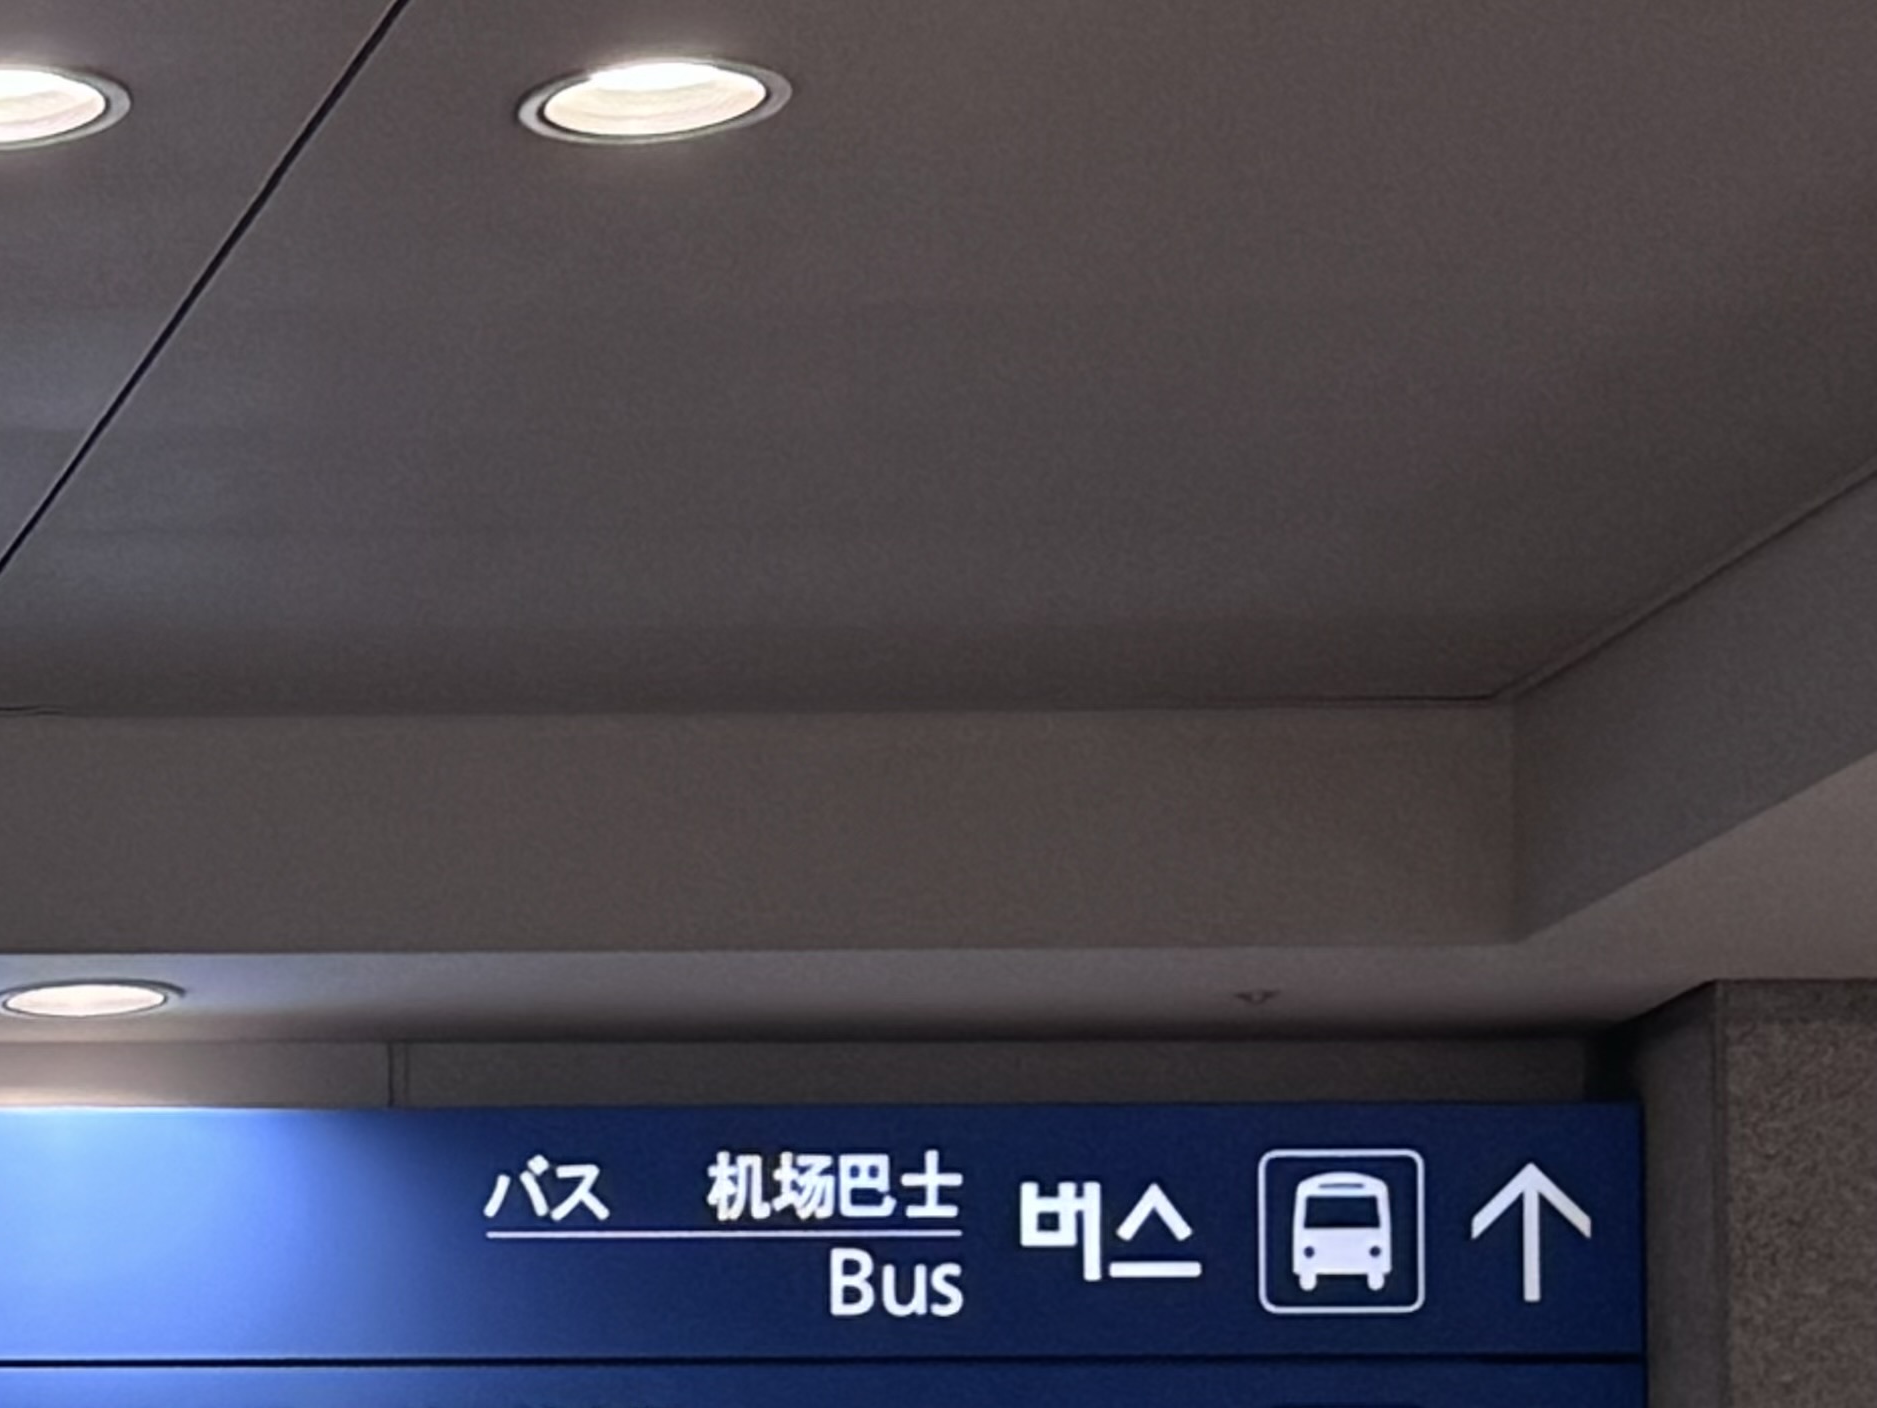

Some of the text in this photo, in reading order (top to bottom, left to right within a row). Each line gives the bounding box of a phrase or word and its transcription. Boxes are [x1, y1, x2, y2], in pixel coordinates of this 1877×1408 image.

[483, 1155, 610, 1221] バス
[707, 1150, 963, 1221] 机场巴士
[1020, 1181, 1202, 1281] 버스
[830, 1247, 964, 1317] Bus
